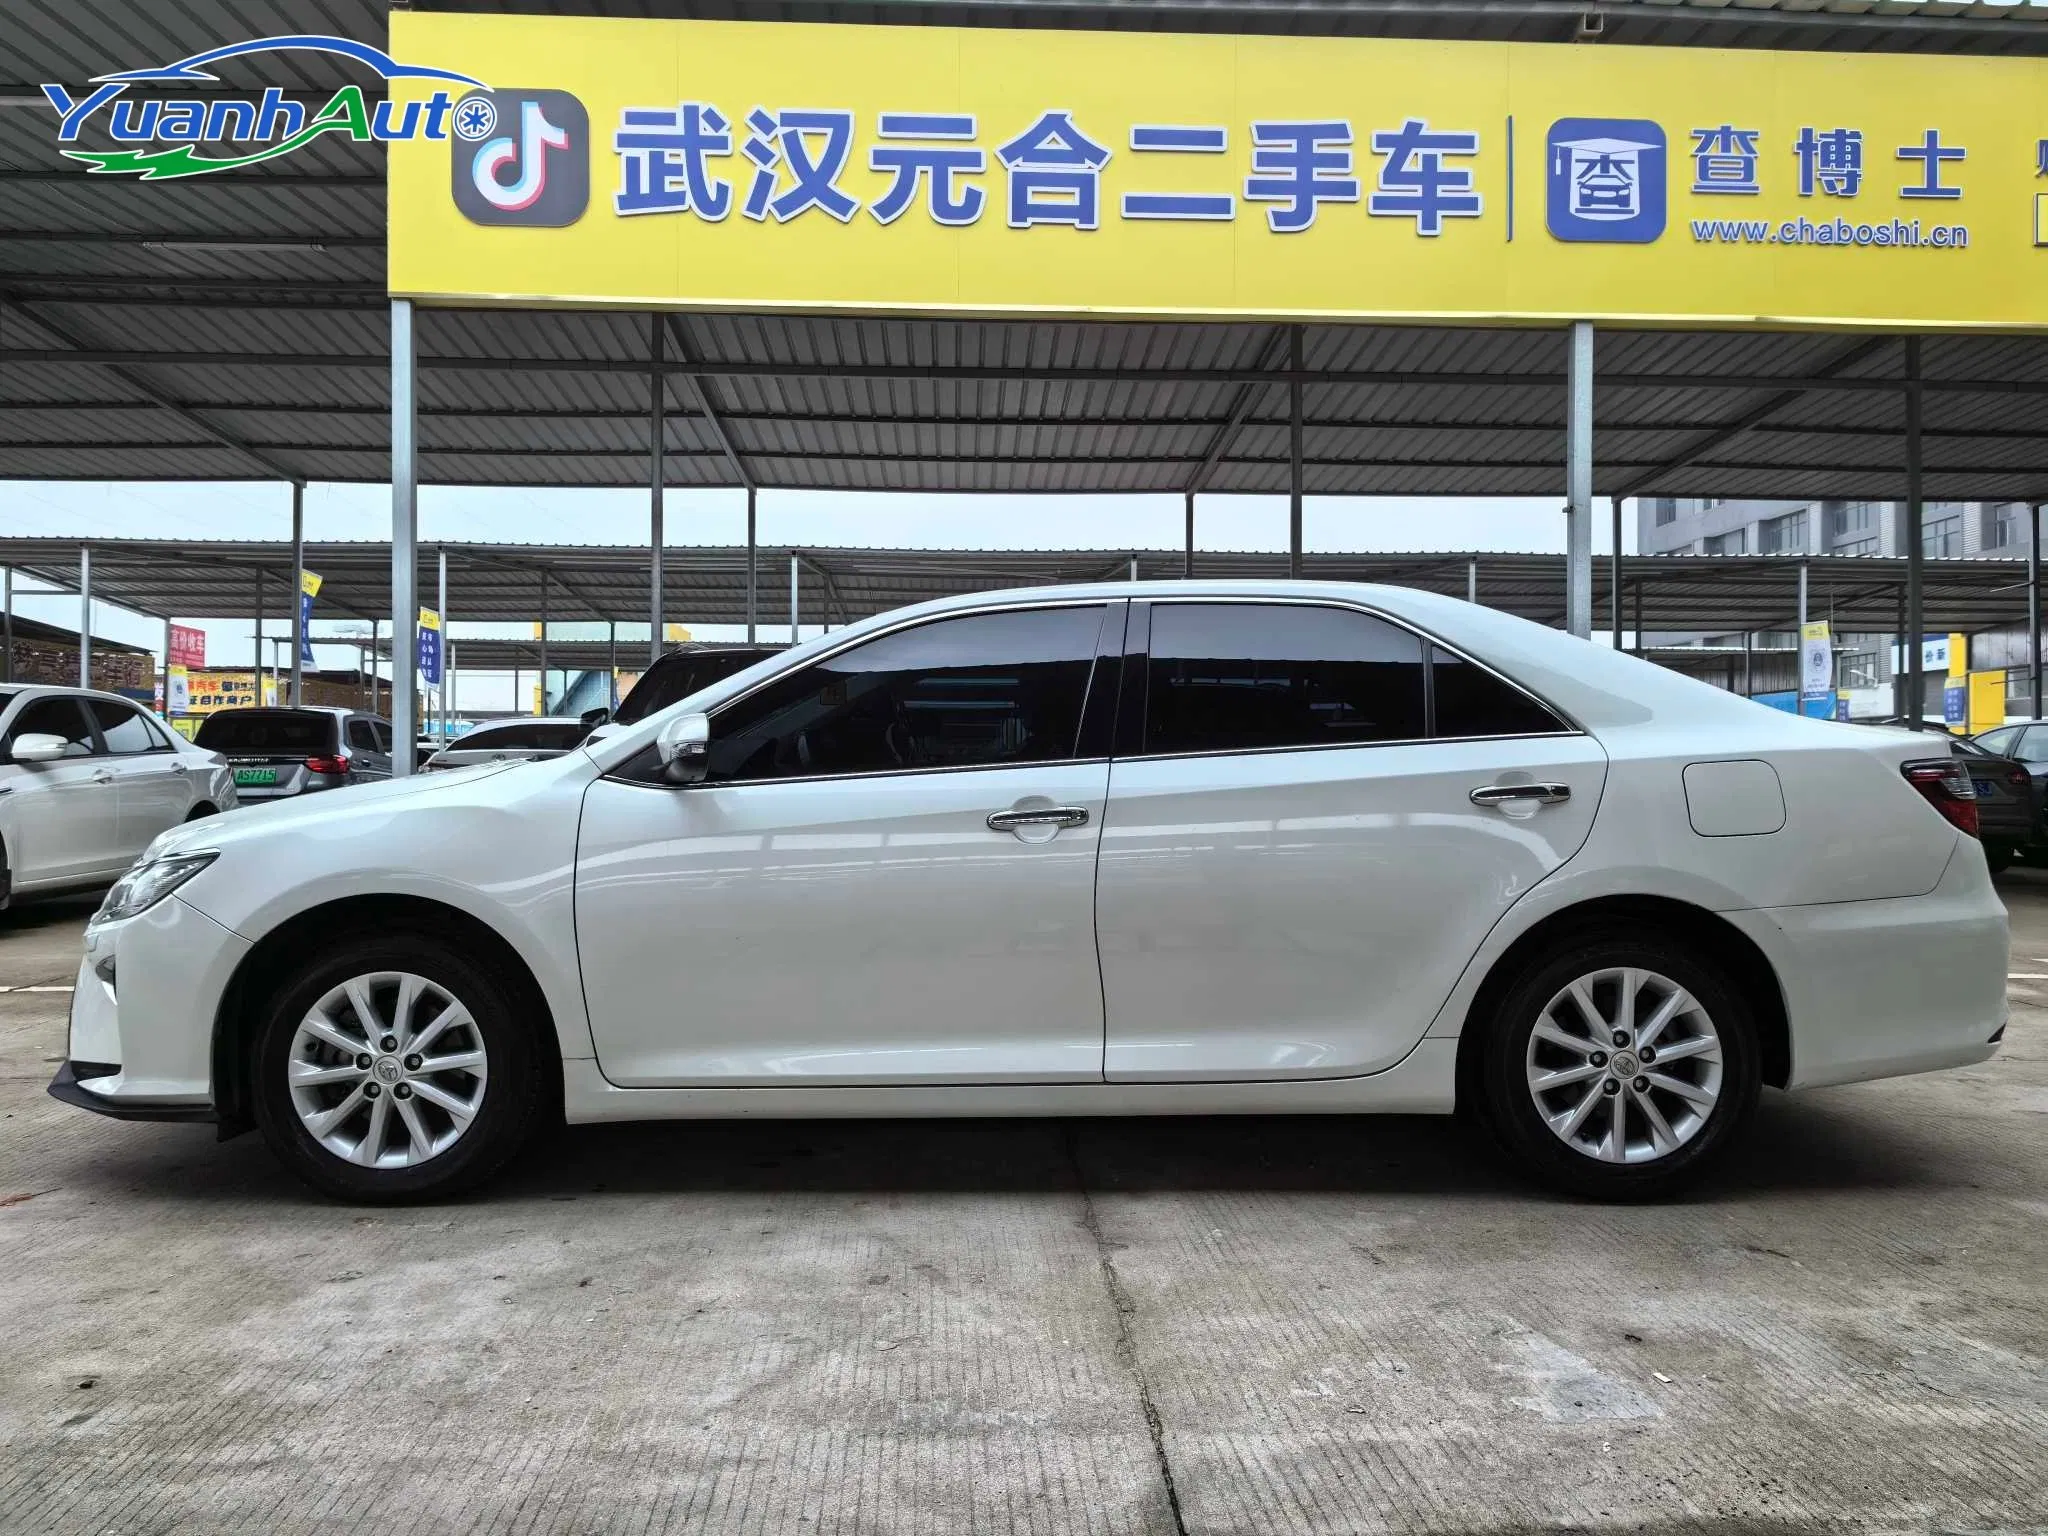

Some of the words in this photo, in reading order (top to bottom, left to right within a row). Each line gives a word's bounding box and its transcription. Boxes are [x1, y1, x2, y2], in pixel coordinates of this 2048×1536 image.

[612, 99, 1484, 236] 武汉元合二手车
[1691, 125, 1967, 199] 查博士
[1692, 216, 1969, 247] www.chaboshi.cn
